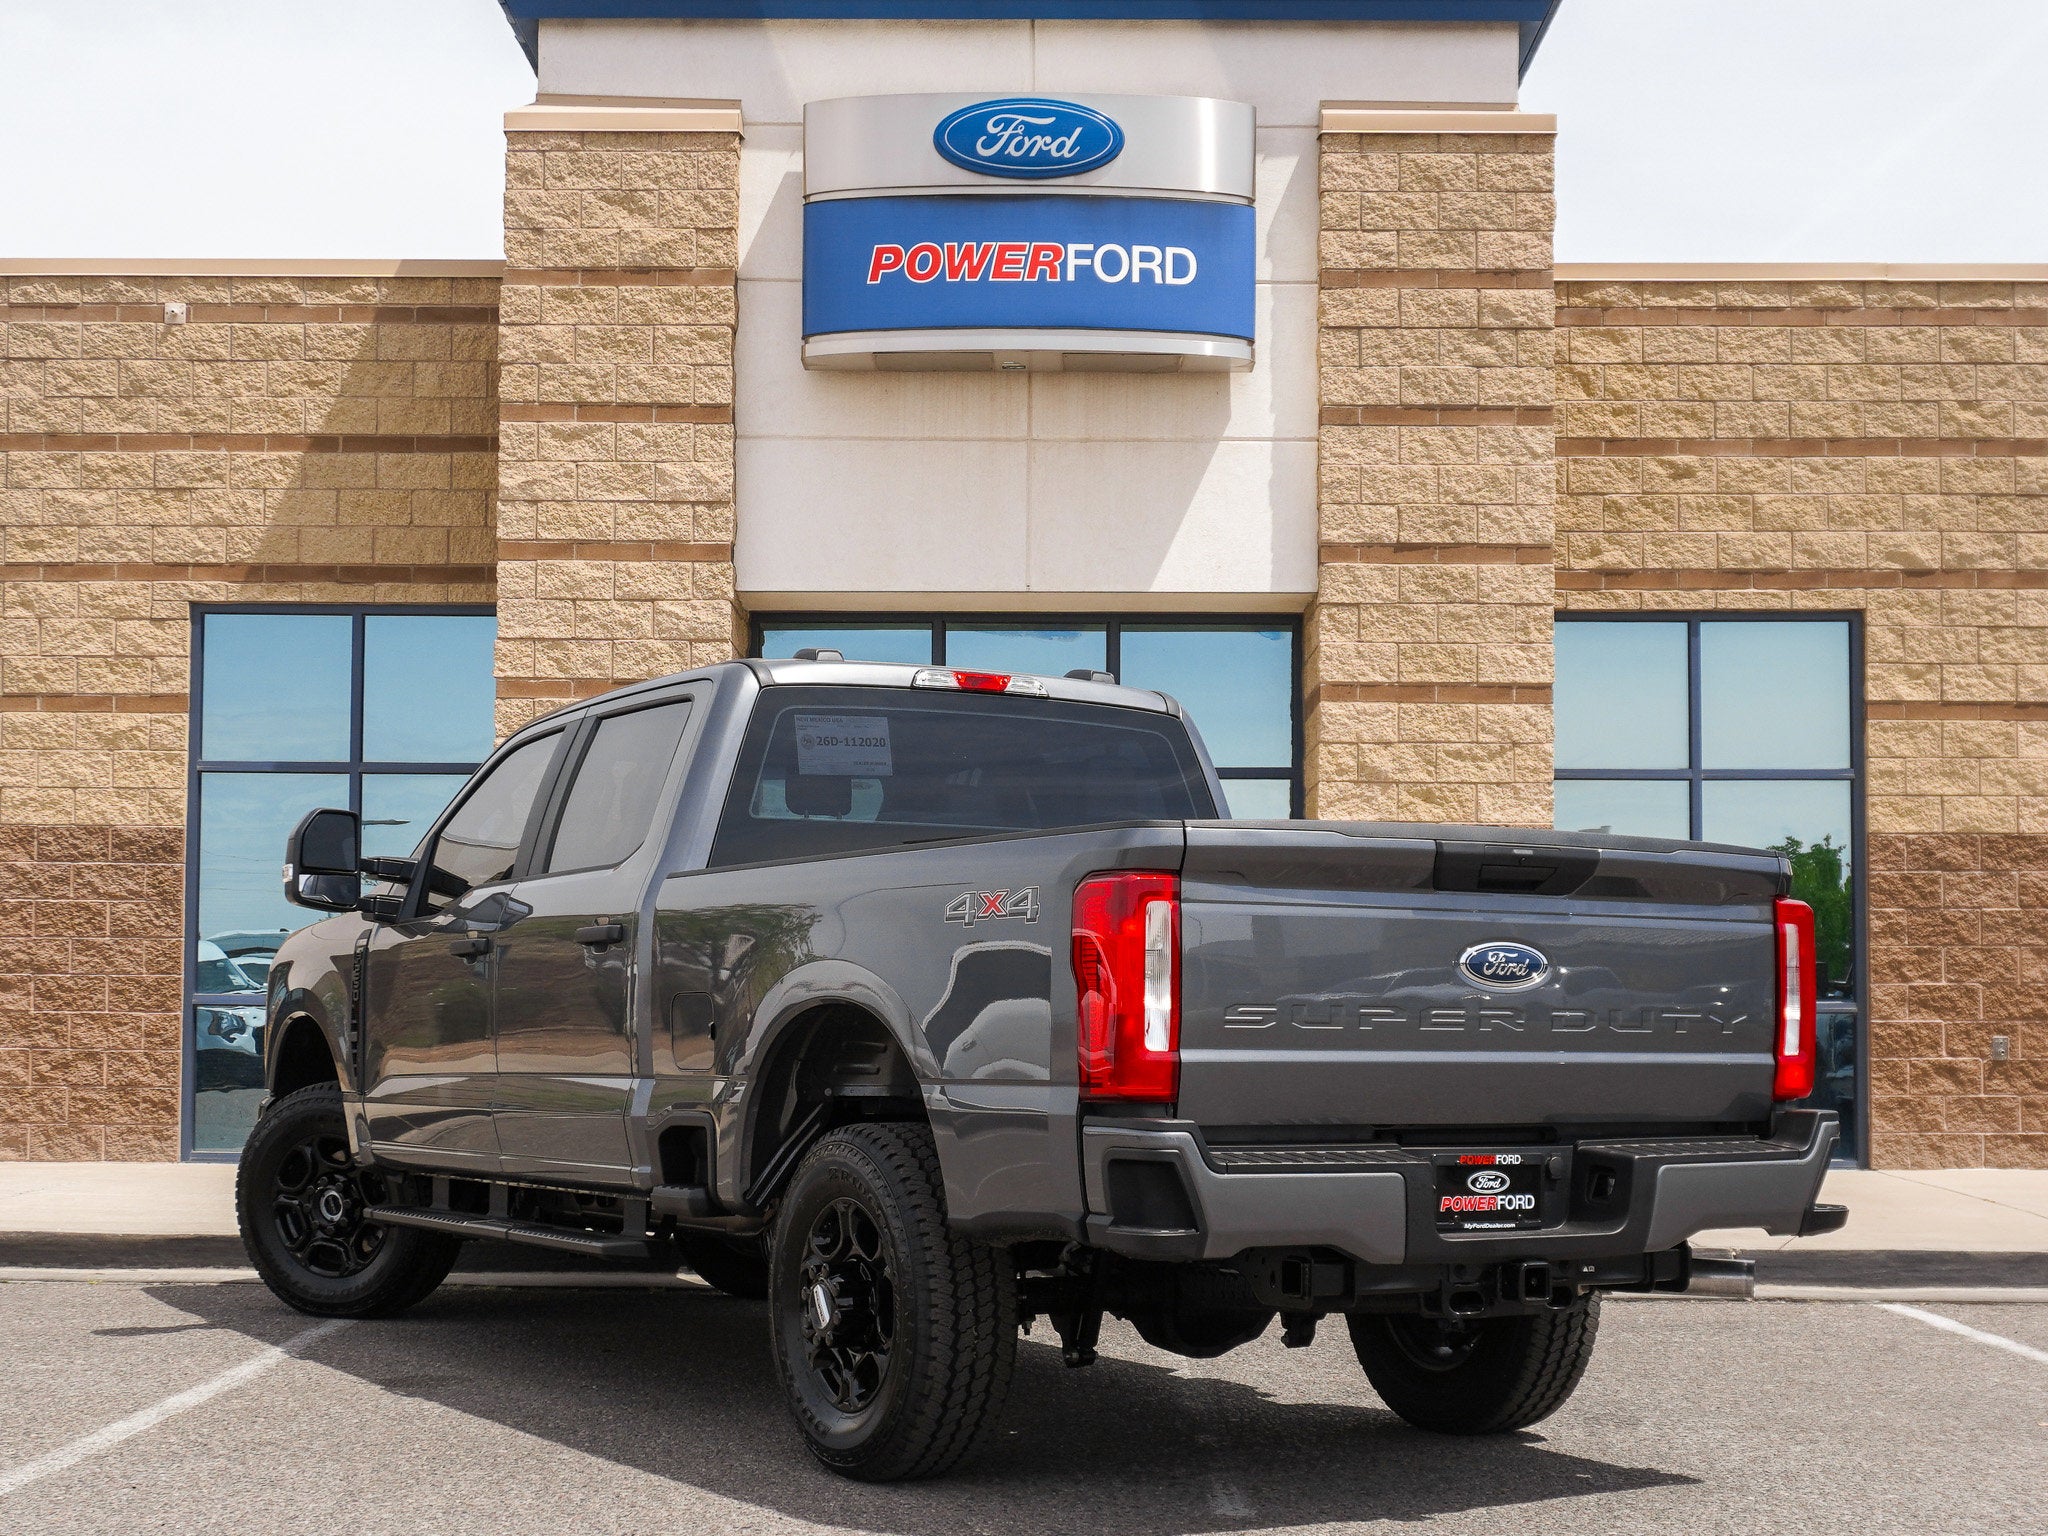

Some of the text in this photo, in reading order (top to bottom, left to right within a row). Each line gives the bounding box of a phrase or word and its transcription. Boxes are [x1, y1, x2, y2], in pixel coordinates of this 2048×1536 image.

[976, 114, 1082, 158] Ford
[816, 736, 887, 748] 26D-112020
[1482, 951, 1531, 977] Ford
[1224, 1004, 1748, 1034] SUPER DUTY
[1476, 1175, 1501, 1188] Ford
